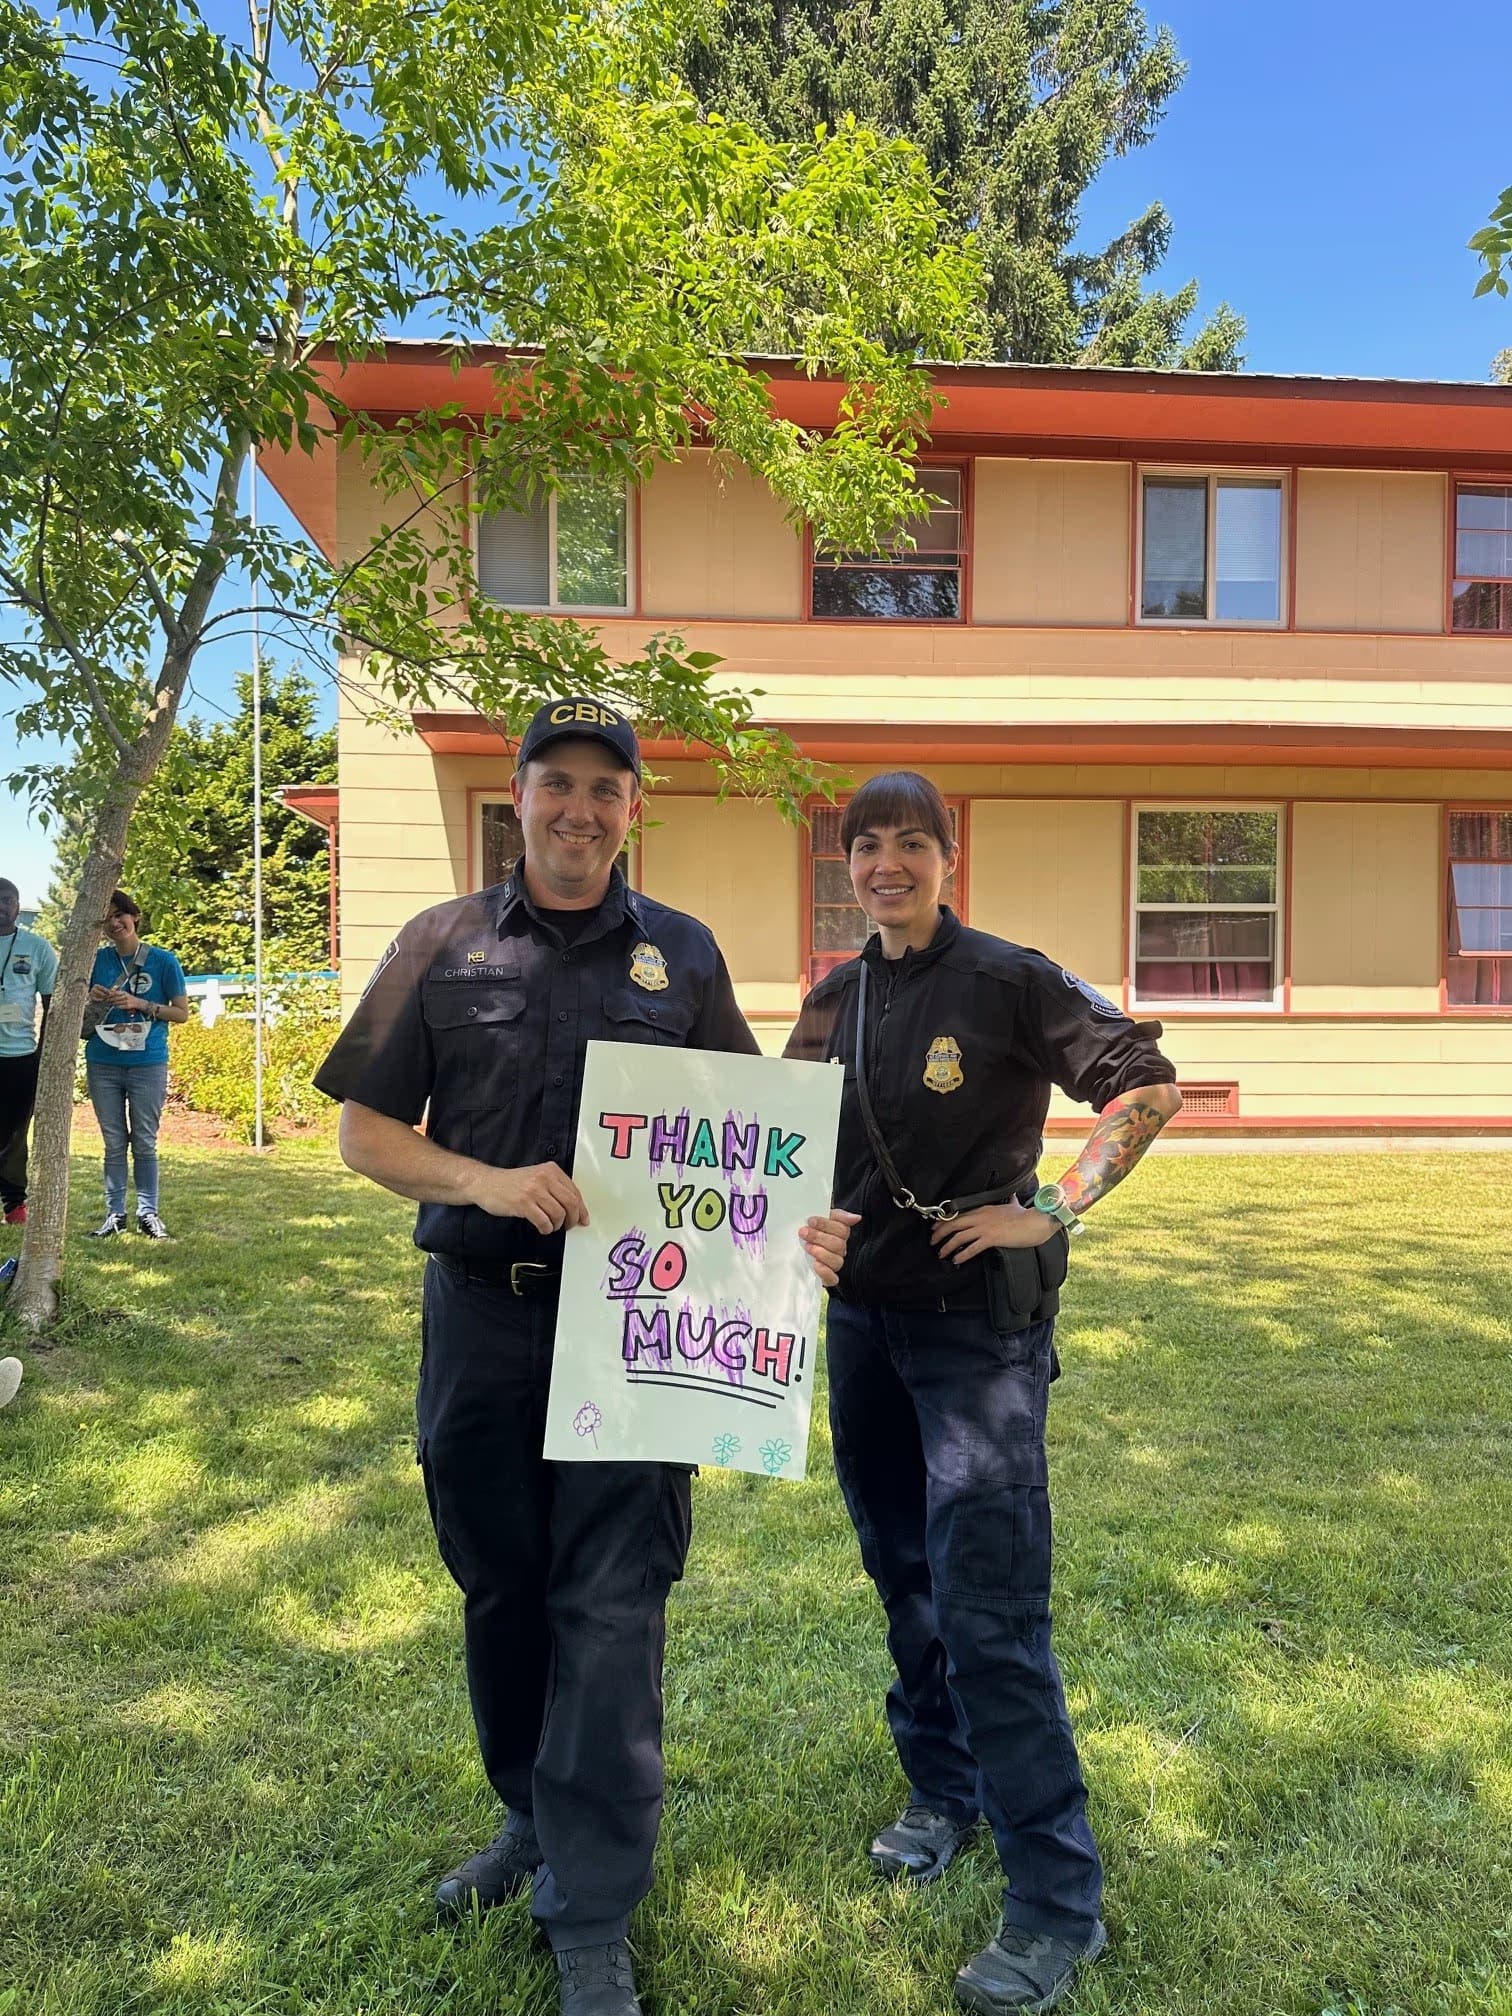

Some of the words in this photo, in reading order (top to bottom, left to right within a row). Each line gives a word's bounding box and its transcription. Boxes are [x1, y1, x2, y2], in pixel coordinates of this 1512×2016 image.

[550, 703, 618, 727] CBP
[444, 967, 504, 977] CHRISTIAN
[599, 1112, 806, 1178] THANK
[658, 1183, 768, 1234] YOU
[608, 1238, 688, 1292] SO
[622, 1309, 806, 1386] MUCH!
